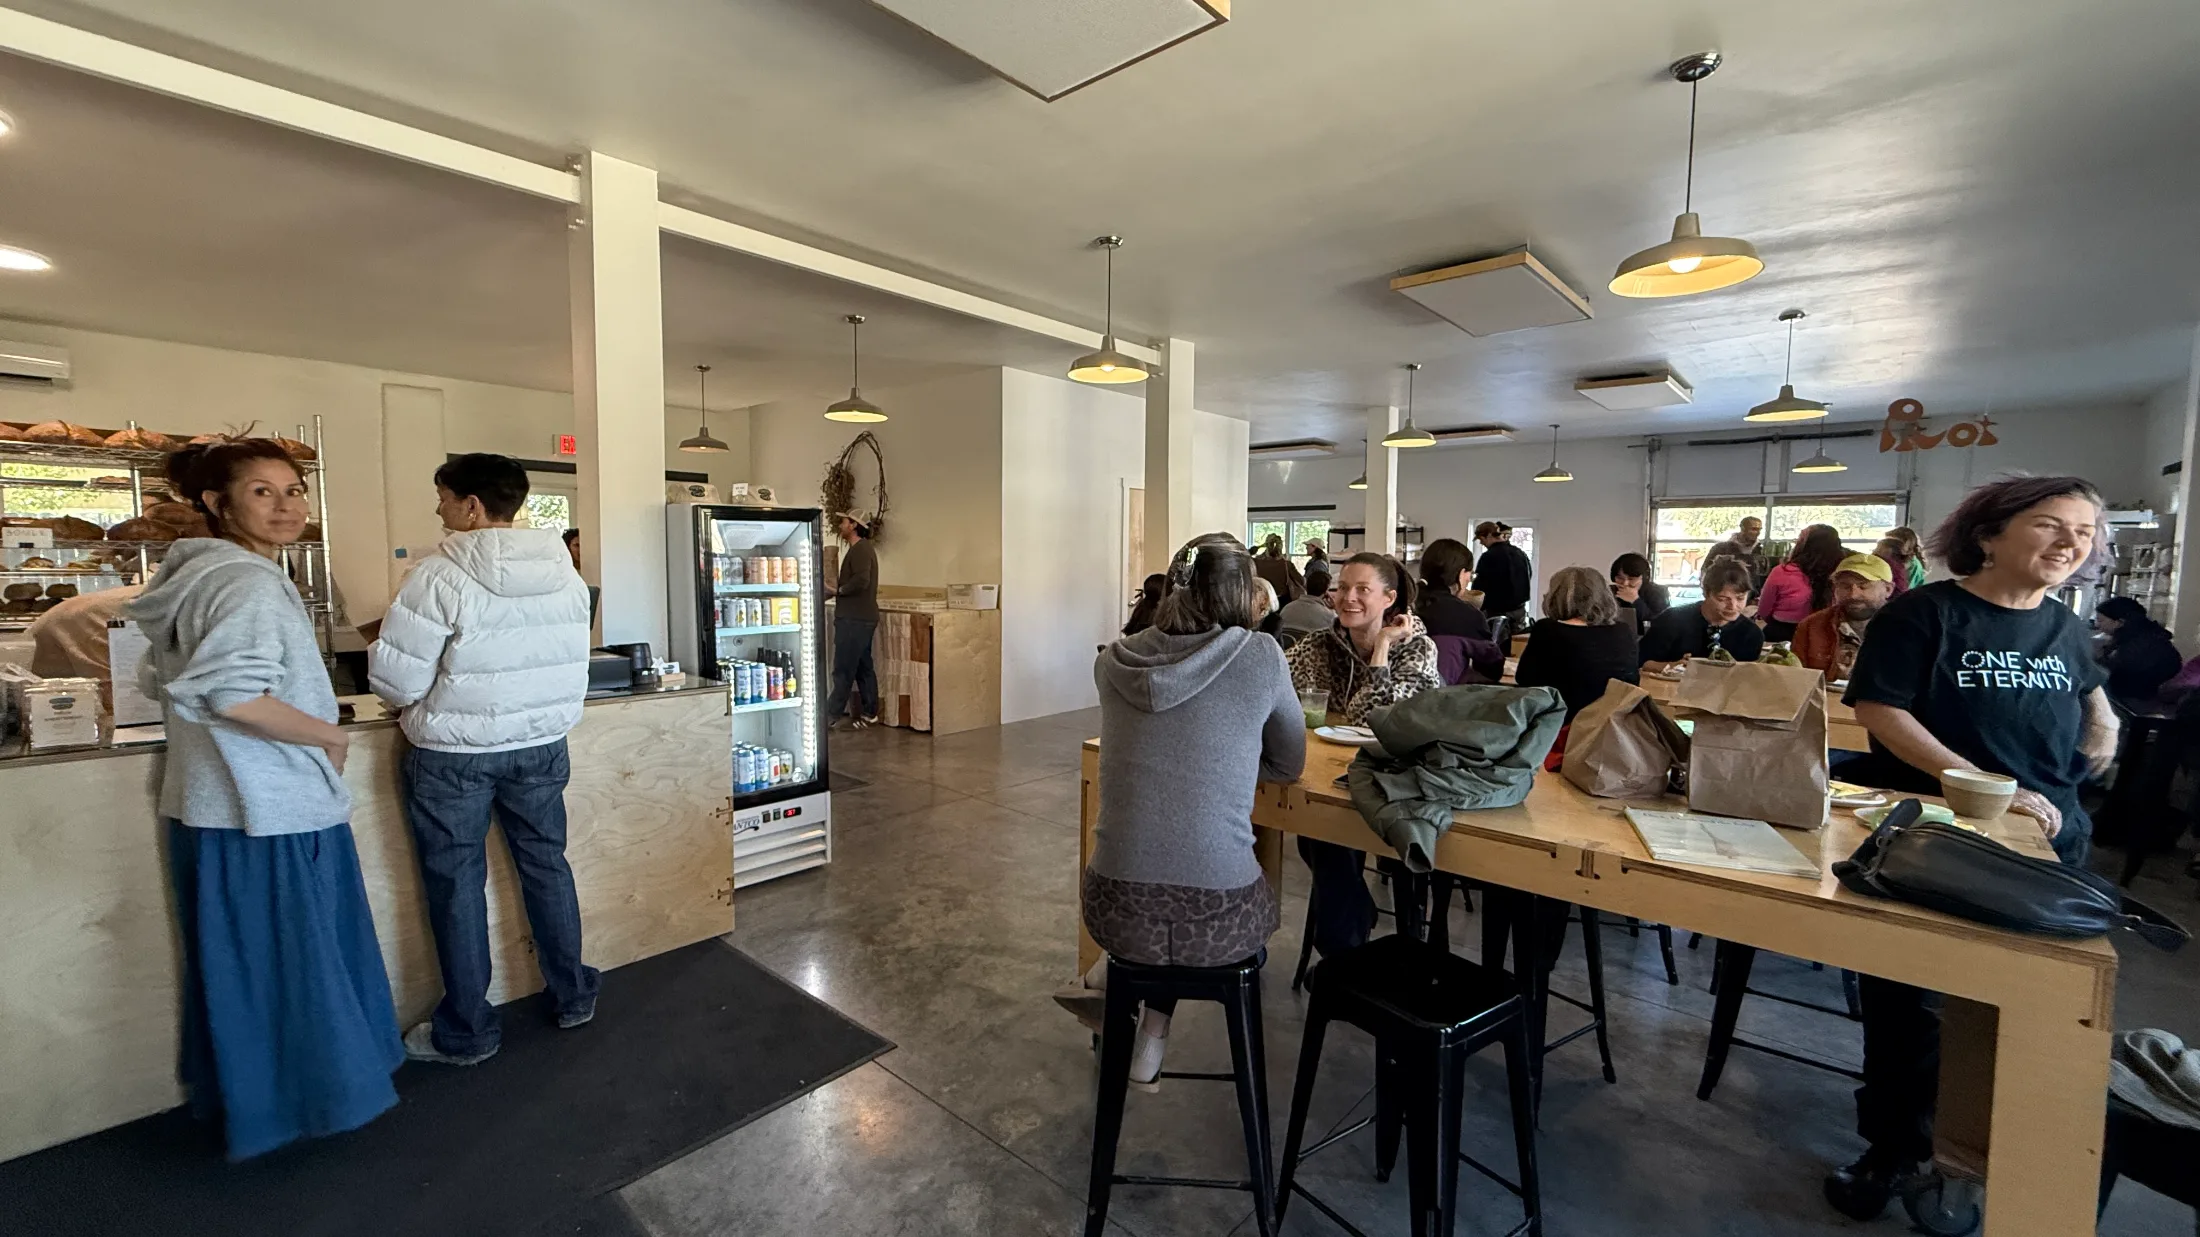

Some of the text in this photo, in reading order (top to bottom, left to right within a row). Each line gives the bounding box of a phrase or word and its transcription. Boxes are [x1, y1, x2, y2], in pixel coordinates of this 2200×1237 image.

[559, 435, 577, 454] EX
[1961, 650, 2022, 670] ONE
[1956, 670, 2072, 692] ETERNITY
[733, 819, 760, 831] ANTCO
